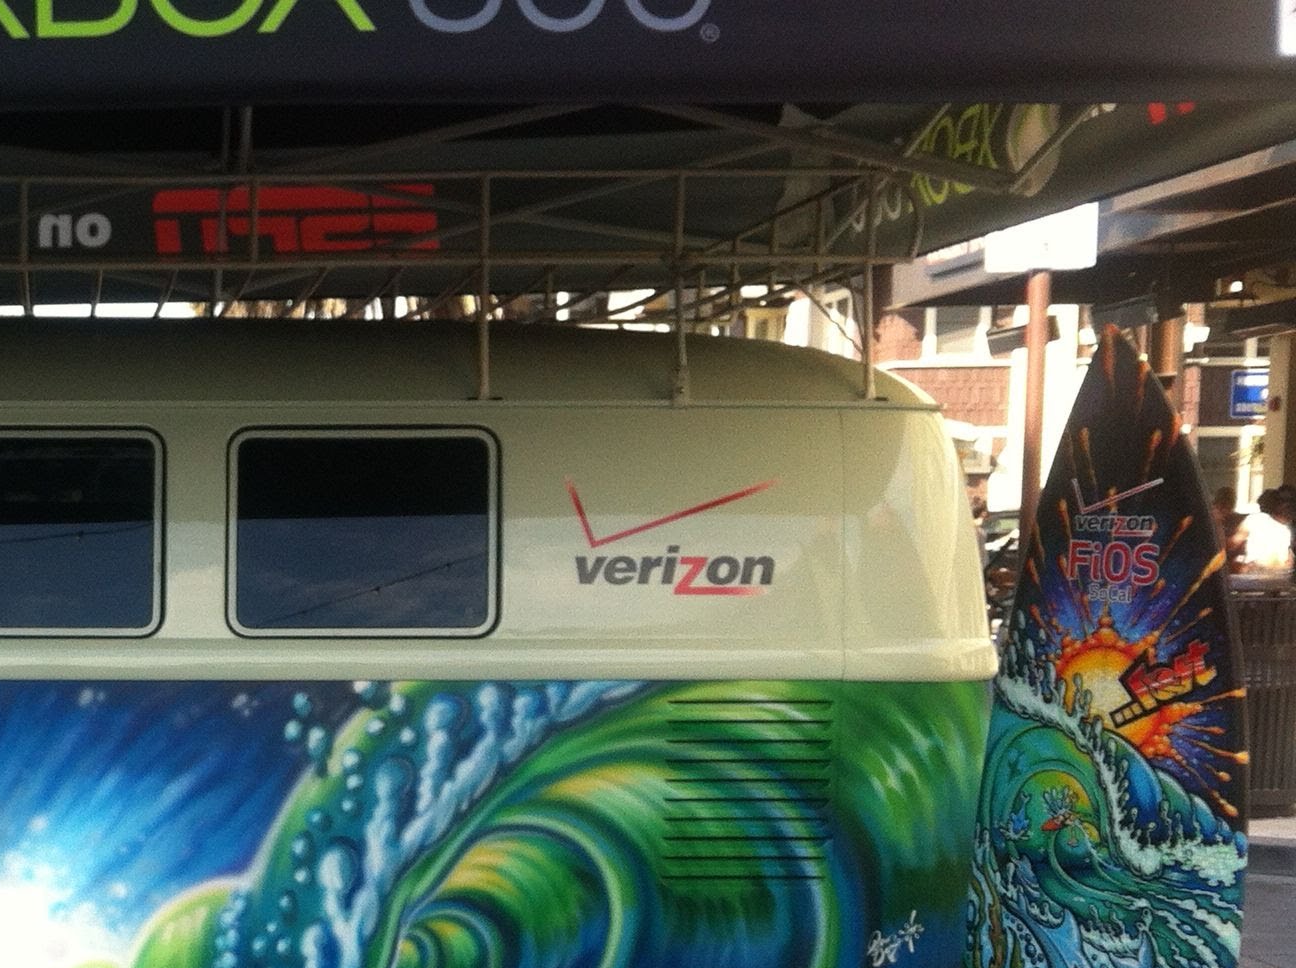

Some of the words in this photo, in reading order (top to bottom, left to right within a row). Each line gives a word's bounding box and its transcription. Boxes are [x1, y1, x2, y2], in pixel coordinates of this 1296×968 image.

[1074, 512, 1156, 537] verizon
[575, 545, 775, 596] verizon
[1067, 539, 1161, 587] FiOS
